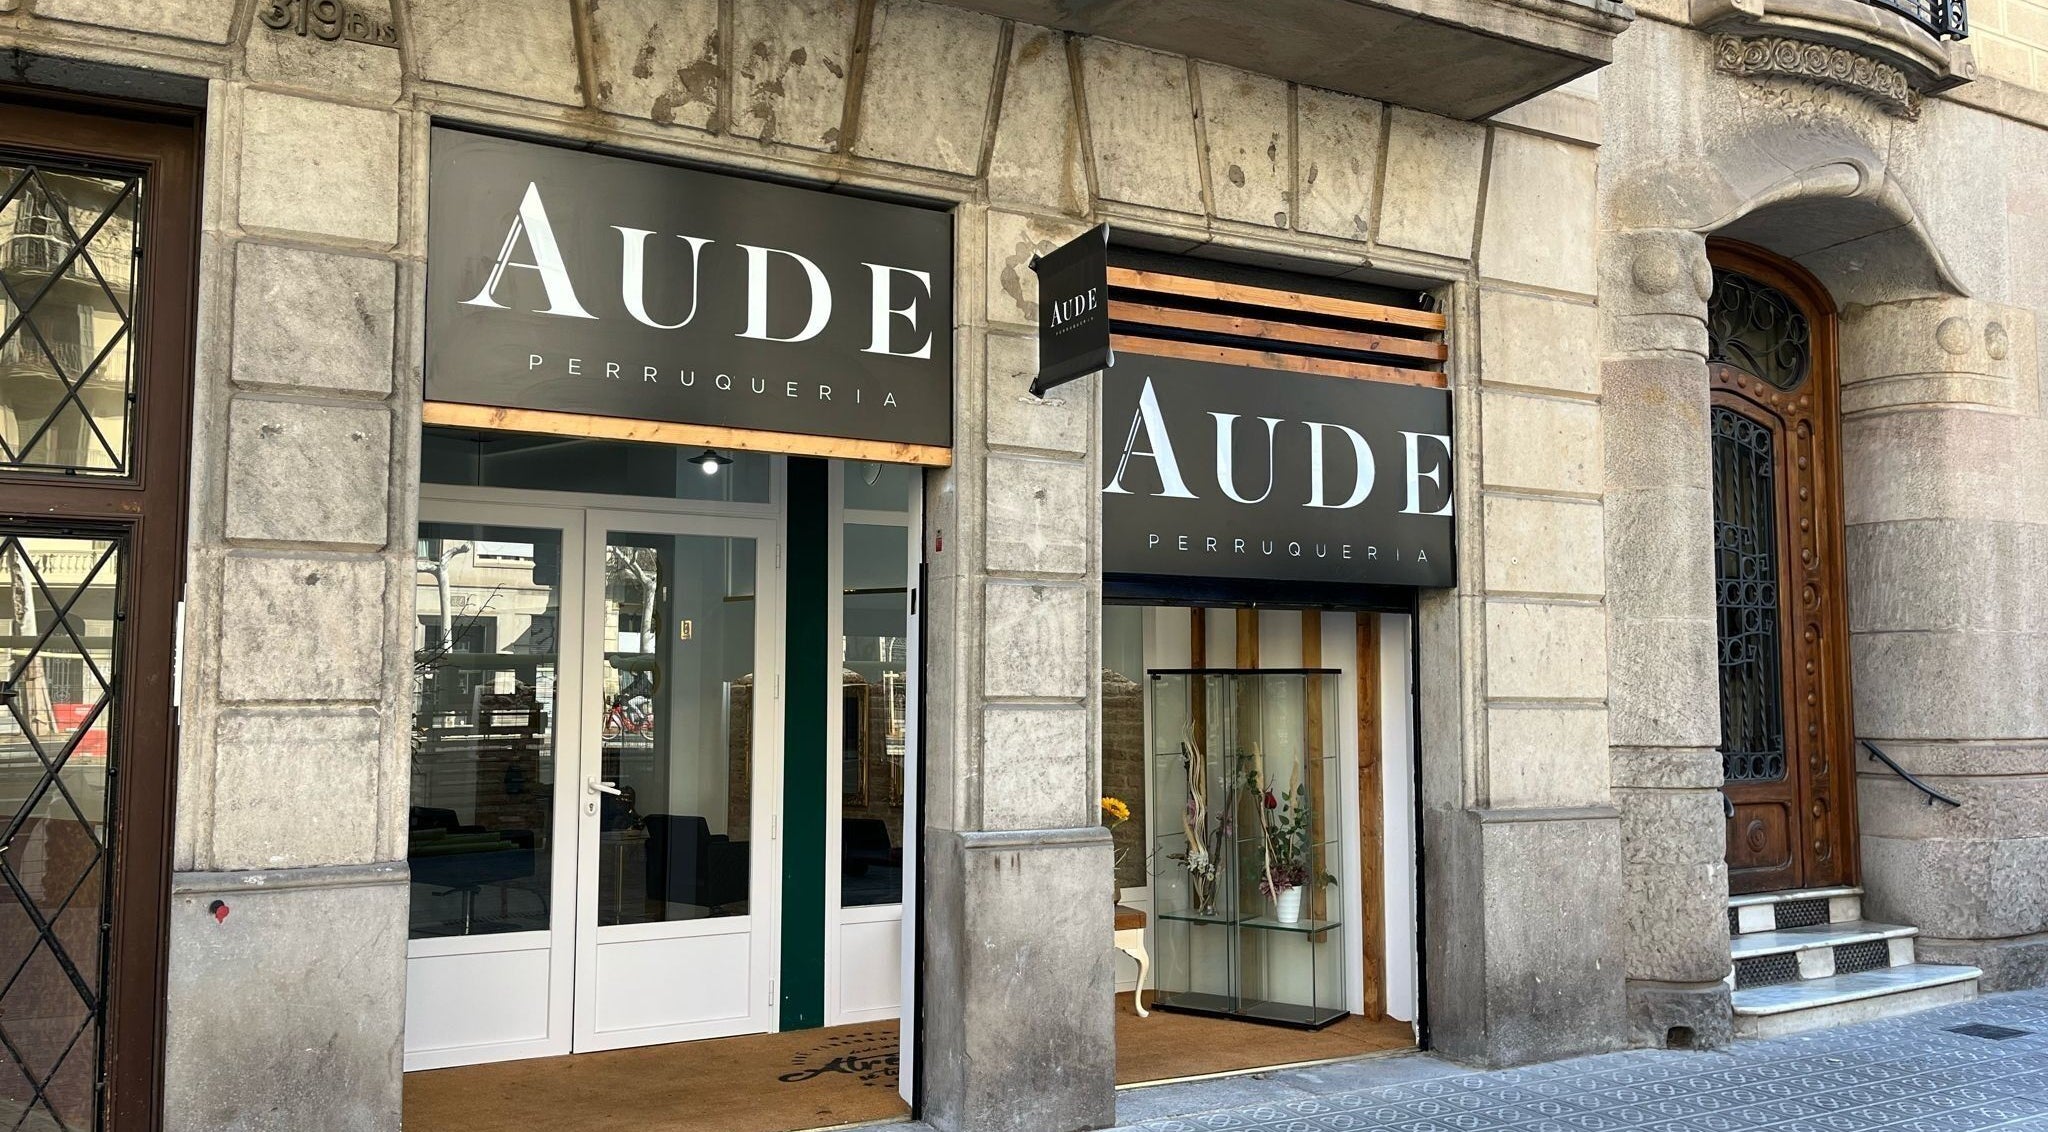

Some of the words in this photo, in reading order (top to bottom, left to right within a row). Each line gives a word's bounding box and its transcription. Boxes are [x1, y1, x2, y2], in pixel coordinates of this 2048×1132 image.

[457, 181, 933, 360] AUDE
[1050, 287, 1098, 328] AUDE
[528, 354, 898, 408] PERRUQUERIA
[1102, 376, 1453, 517] AUDE
[1149, 533, 1428, 563] PERRUQUERIA
